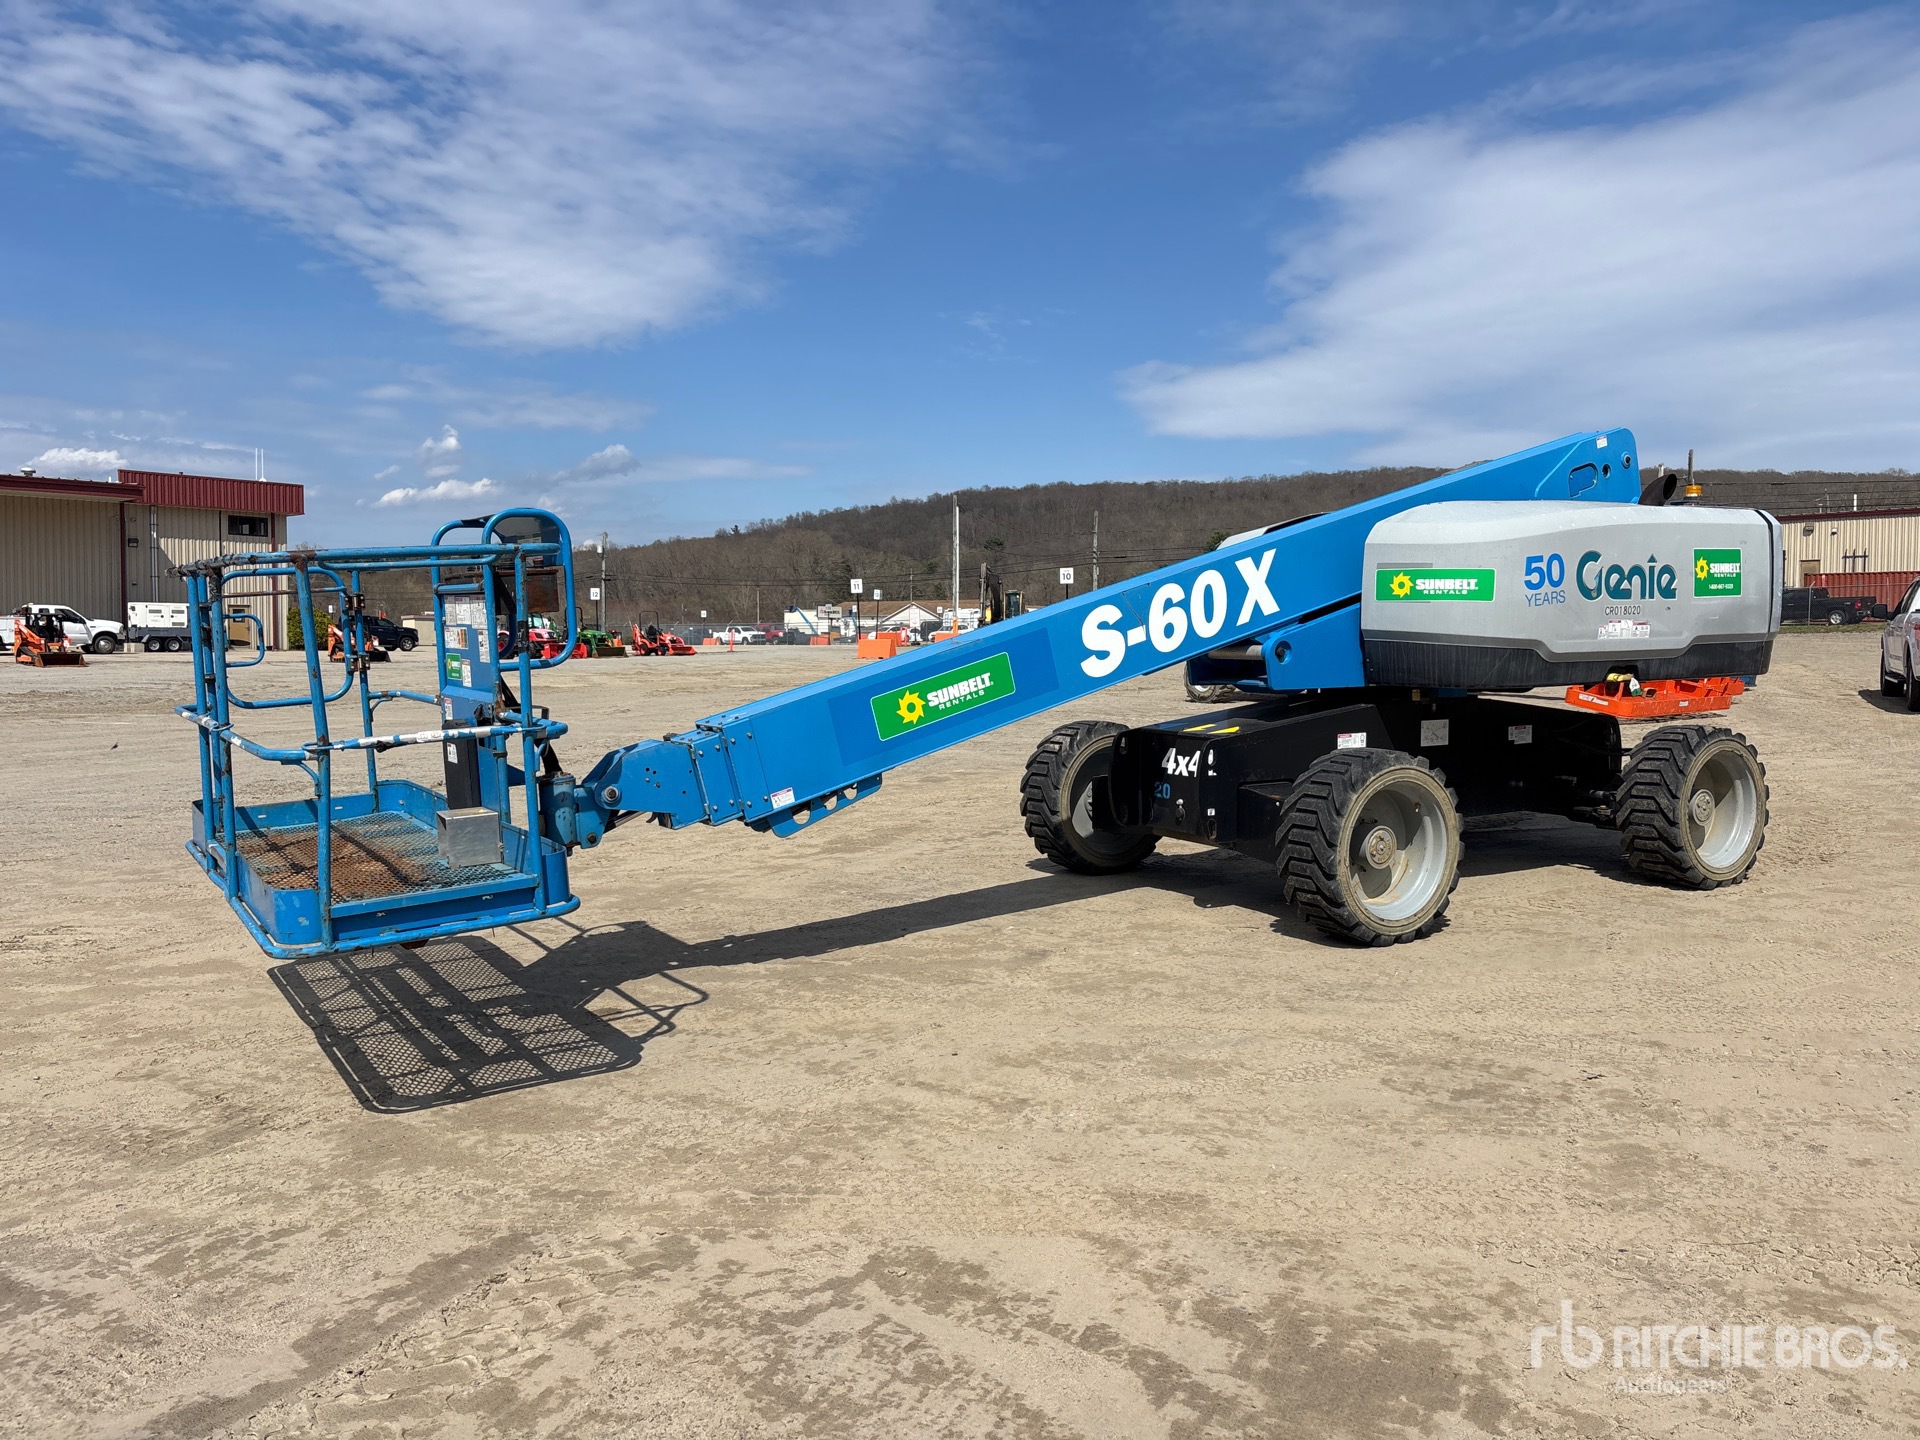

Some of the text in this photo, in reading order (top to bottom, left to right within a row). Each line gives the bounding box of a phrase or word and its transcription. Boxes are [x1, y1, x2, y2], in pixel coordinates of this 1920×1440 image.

[1062, 572, 1071, 581] 10
[1523, 552, 1565, 591] 50
[1575, 550, 1678, 601] Genie
[1709, 562, 1741, 574] SUNBELT
[1415, 578, 1478, 590] SUNBELT
[1525, 590, 1566, 607] YEARS
[1080, 548, 1281, 678] S-60 X
[1604, 605, 1641, 616] CR018020
[926, 672, 992, 707] SUNBELT
[938, 690, 985, 711] RENTALS
[1161, 747, 1201, 778] 4x4
